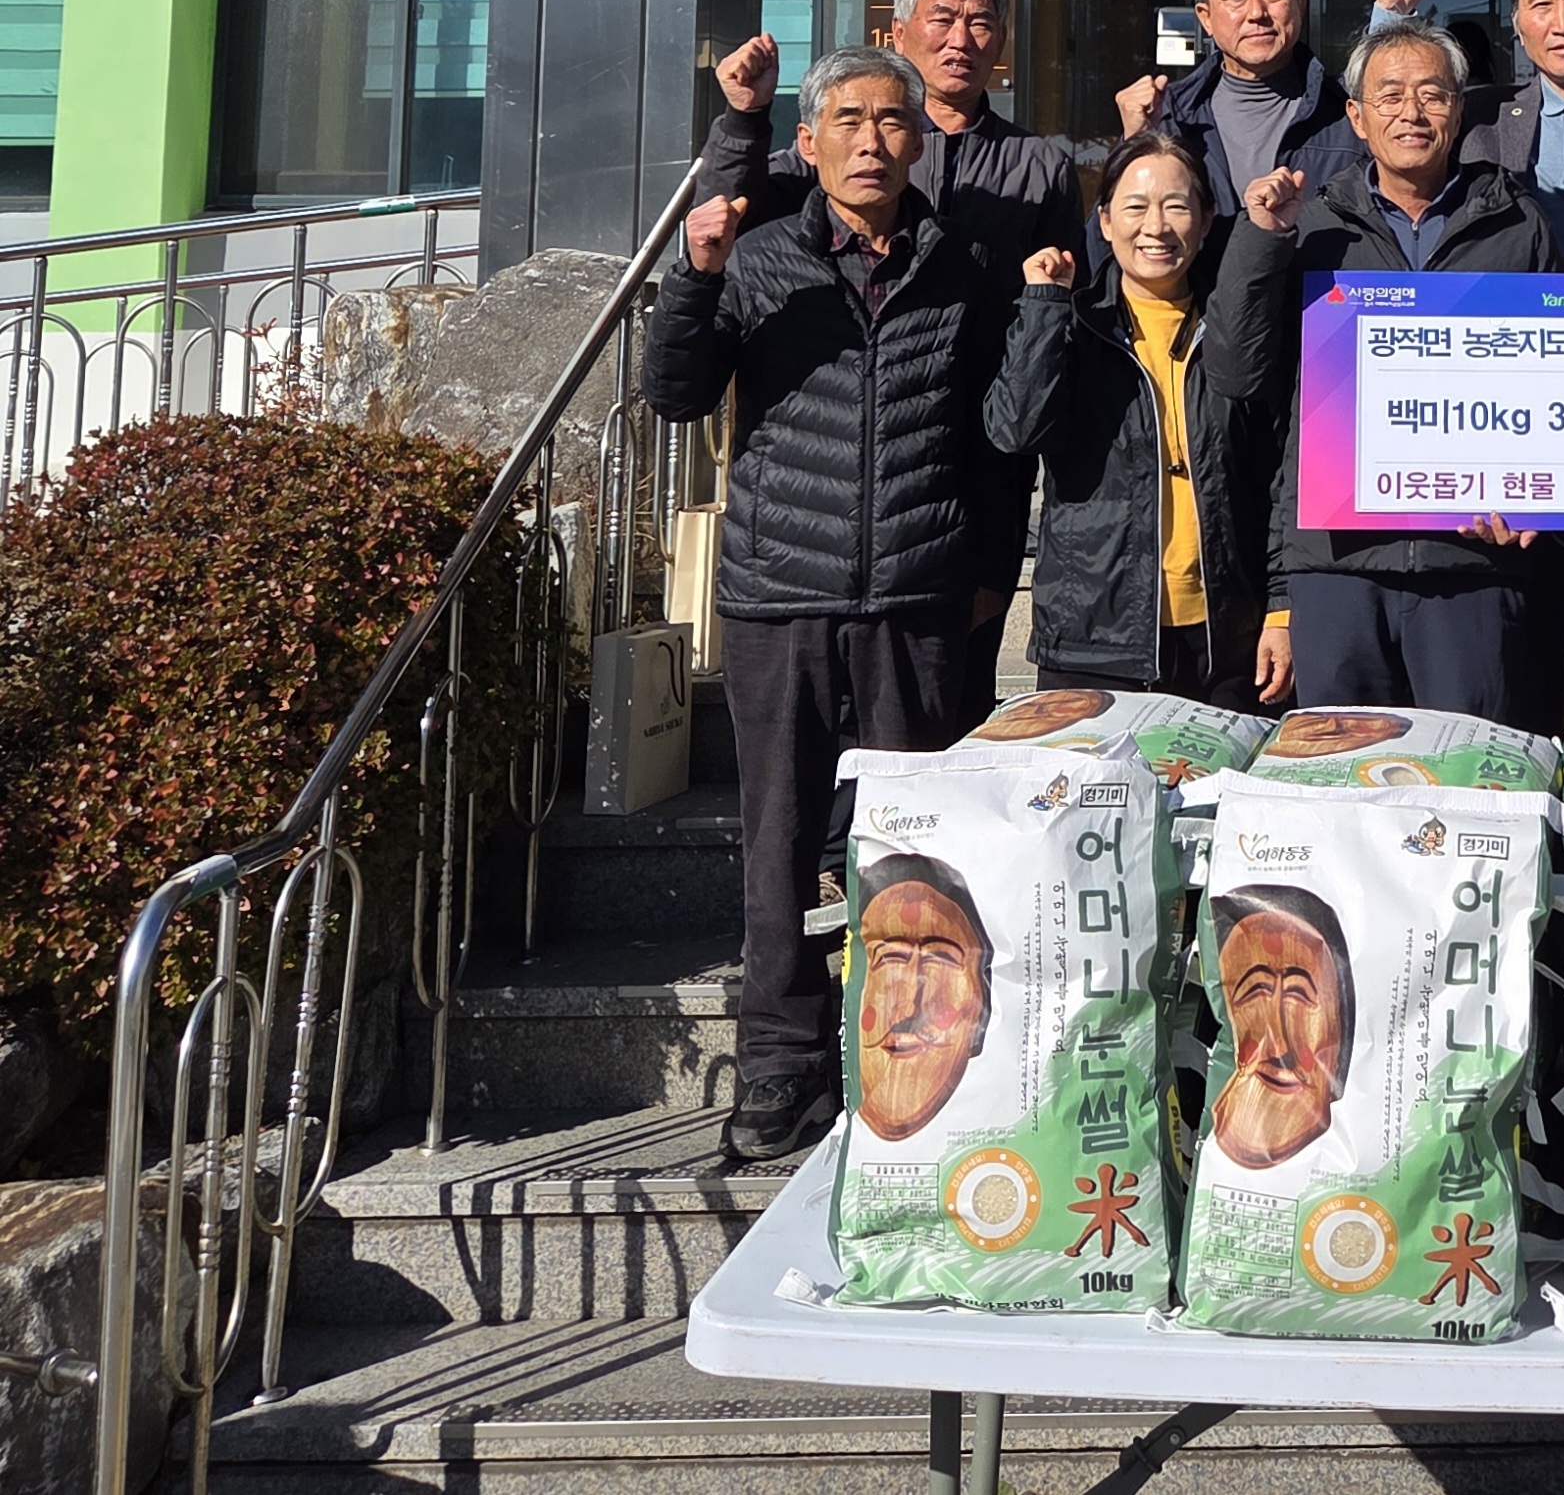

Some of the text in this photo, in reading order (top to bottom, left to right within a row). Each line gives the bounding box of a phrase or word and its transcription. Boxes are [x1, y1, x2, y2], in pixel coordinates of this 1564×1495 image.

[871, 28, 894, 48] 1F
[1349, 286, 1416, 301] 사랑의열매
[1367, 326, 1451, 358] 광적면
[1386, 398, 1531, 435] 백미10kg
[1377, 471, 1485, 500] 이웃돕기
[1501, 471, 1555, 500] 현물
[1084, 788, 1124, 803] 경기미
[1462, 838, 1505, 855] 경기미
[1079, 1271, 1134, 1294] 10kg
[1431, 1320, 1485, 1342] 10kg
